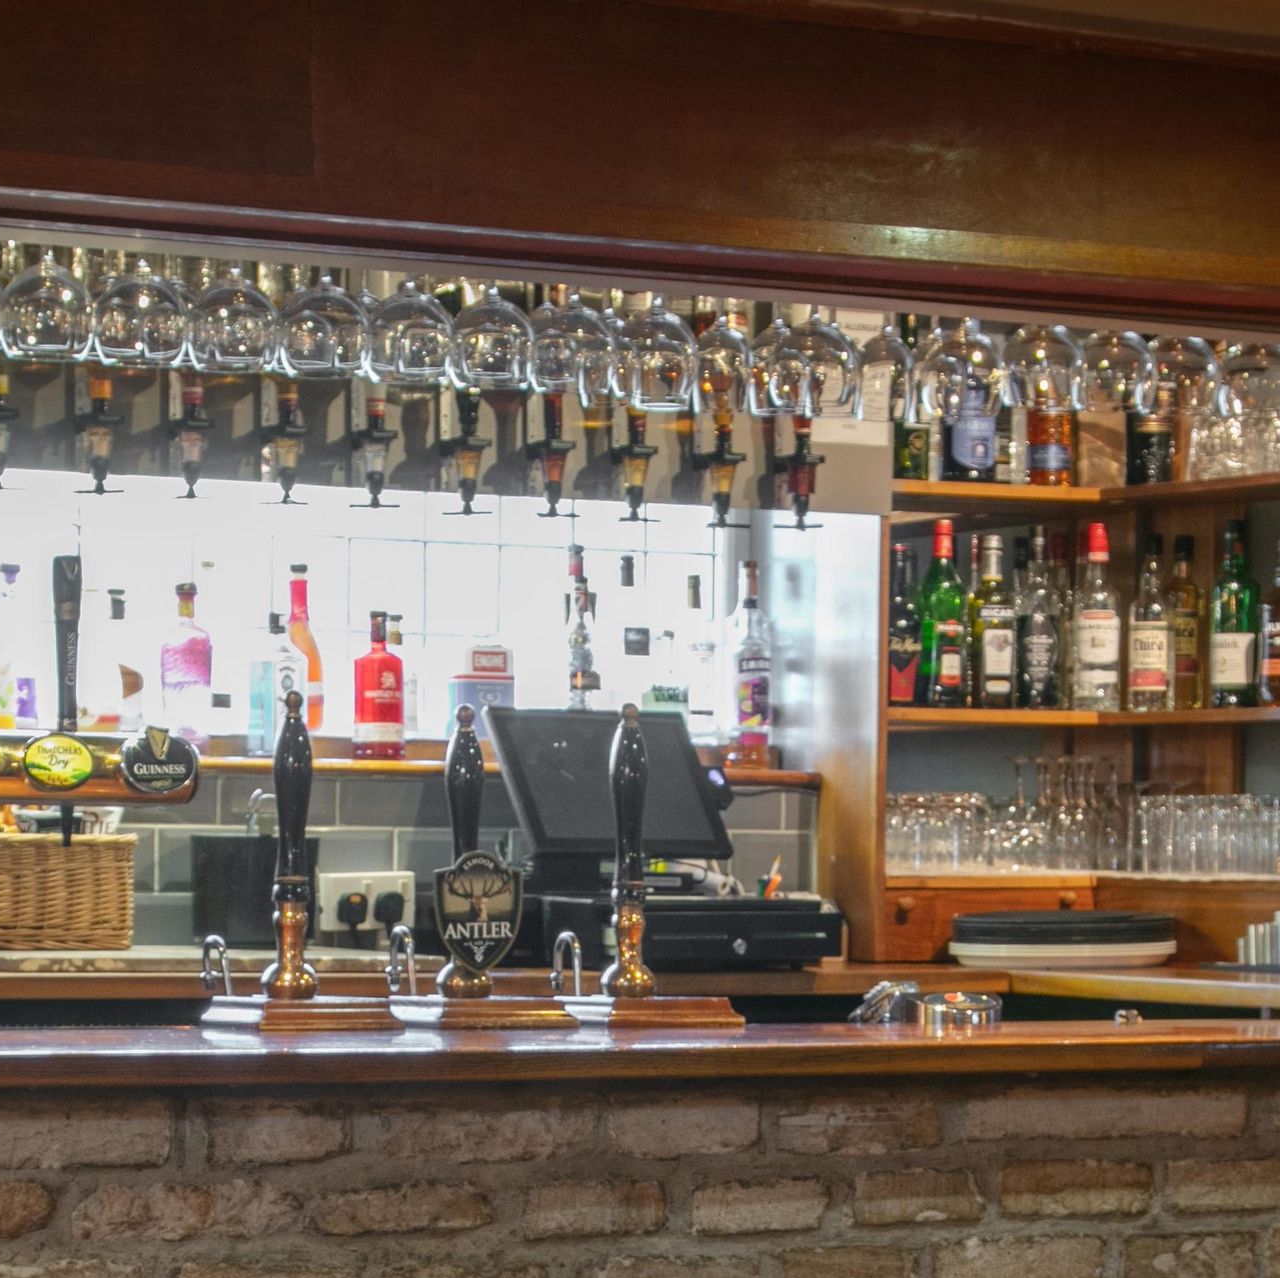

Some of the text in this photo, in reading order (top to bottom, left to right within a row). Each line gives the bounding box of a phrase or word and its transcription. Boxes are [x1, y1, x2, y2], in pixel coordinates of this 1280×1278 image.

[64, 631, 77, 686] GUINNESS
[474, 655, 504, 668] ENGINE
[36, 745, 83, 755] THATCHERS
[47, 754, 70, 769] Dry
[133, 763, 187, 776] GUINNESS
[462, 857, 495, 871] EXMOOR
[443, 920, 514, 939] ANTLER
